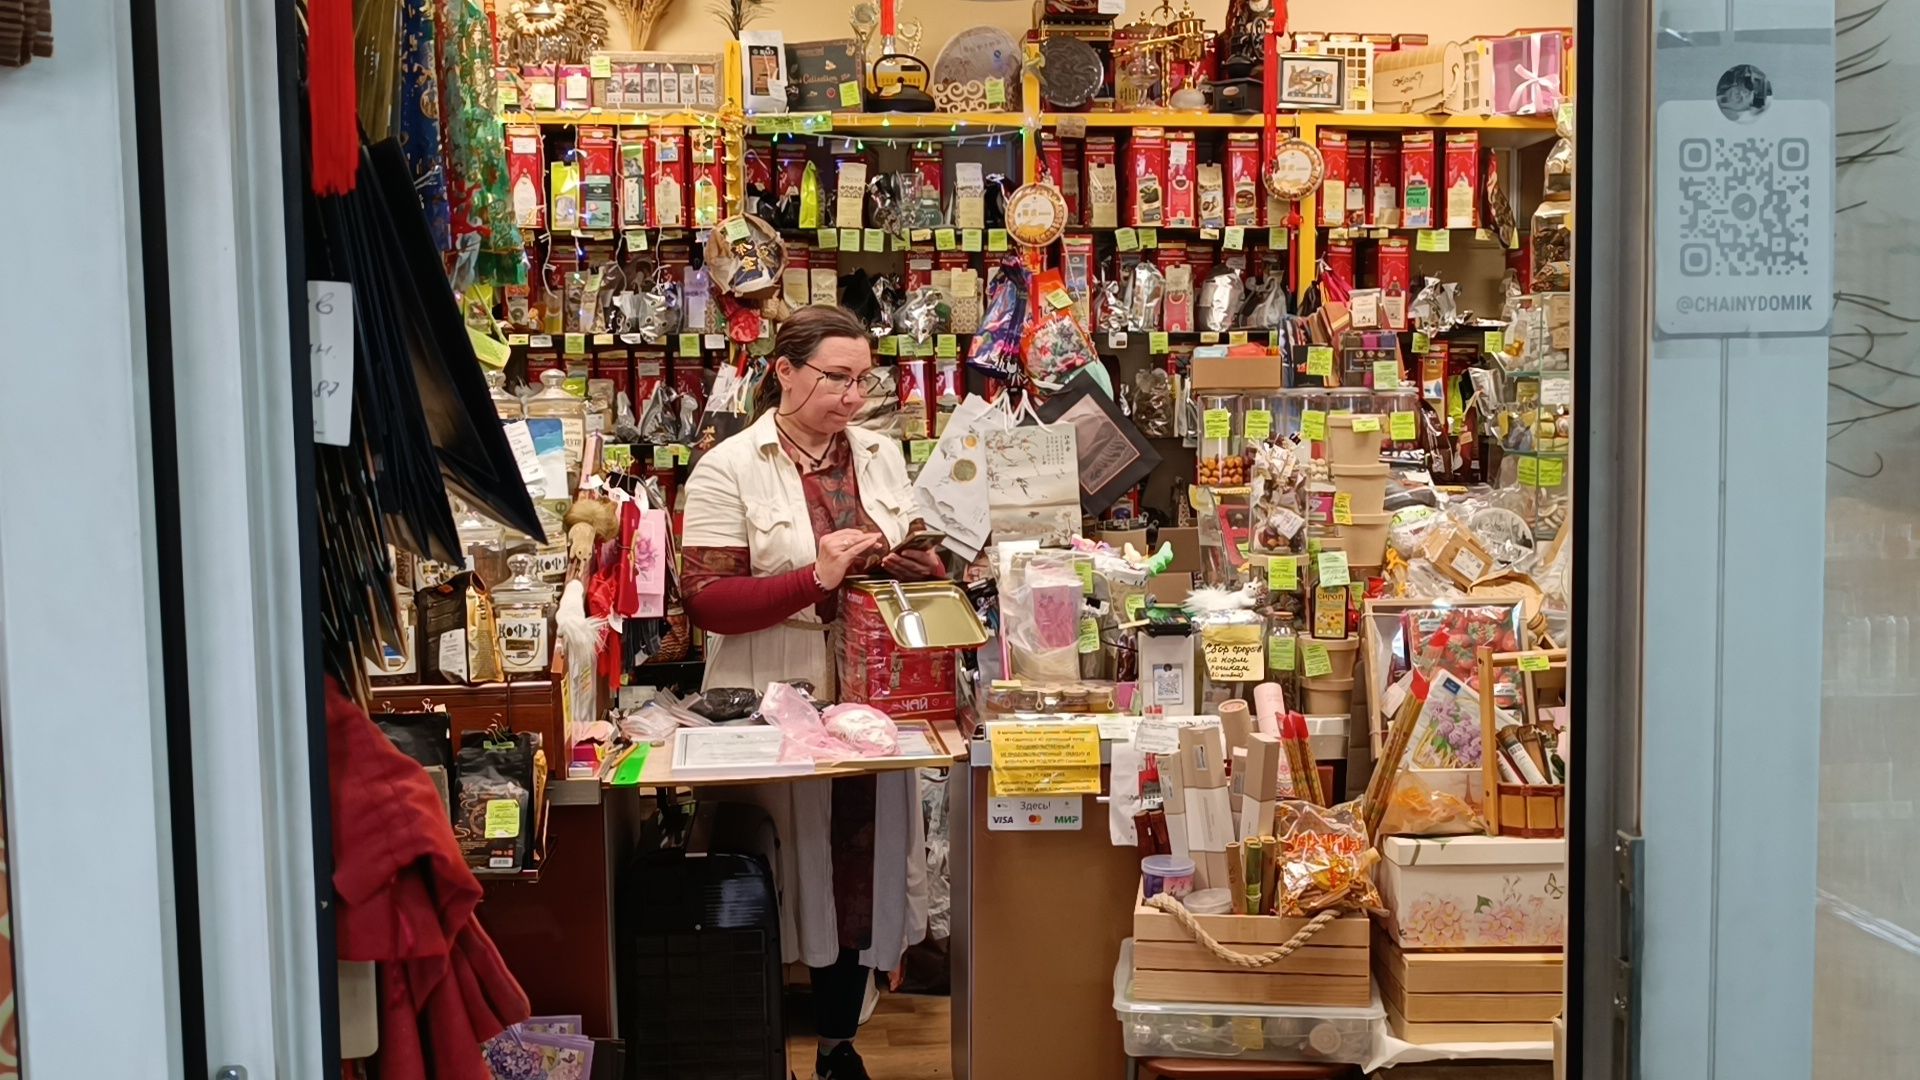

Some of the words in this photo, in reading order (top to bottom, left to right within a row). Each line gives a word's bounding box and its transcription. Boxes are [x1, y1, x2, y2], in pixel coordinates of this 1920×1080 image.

[1676, 295, 1813, 315] @CHAINYDOMIK
[535, 557, 567, 575] КОФ
[1205, 642, 1229, 655] Сбор
[901, 696, 929, 712] ЧАЙ
[1020, 801, 1051, 811] Здесь!
[992, 816, 1014, 824] VISA
[1054, 816, 1080, 824] МИР
